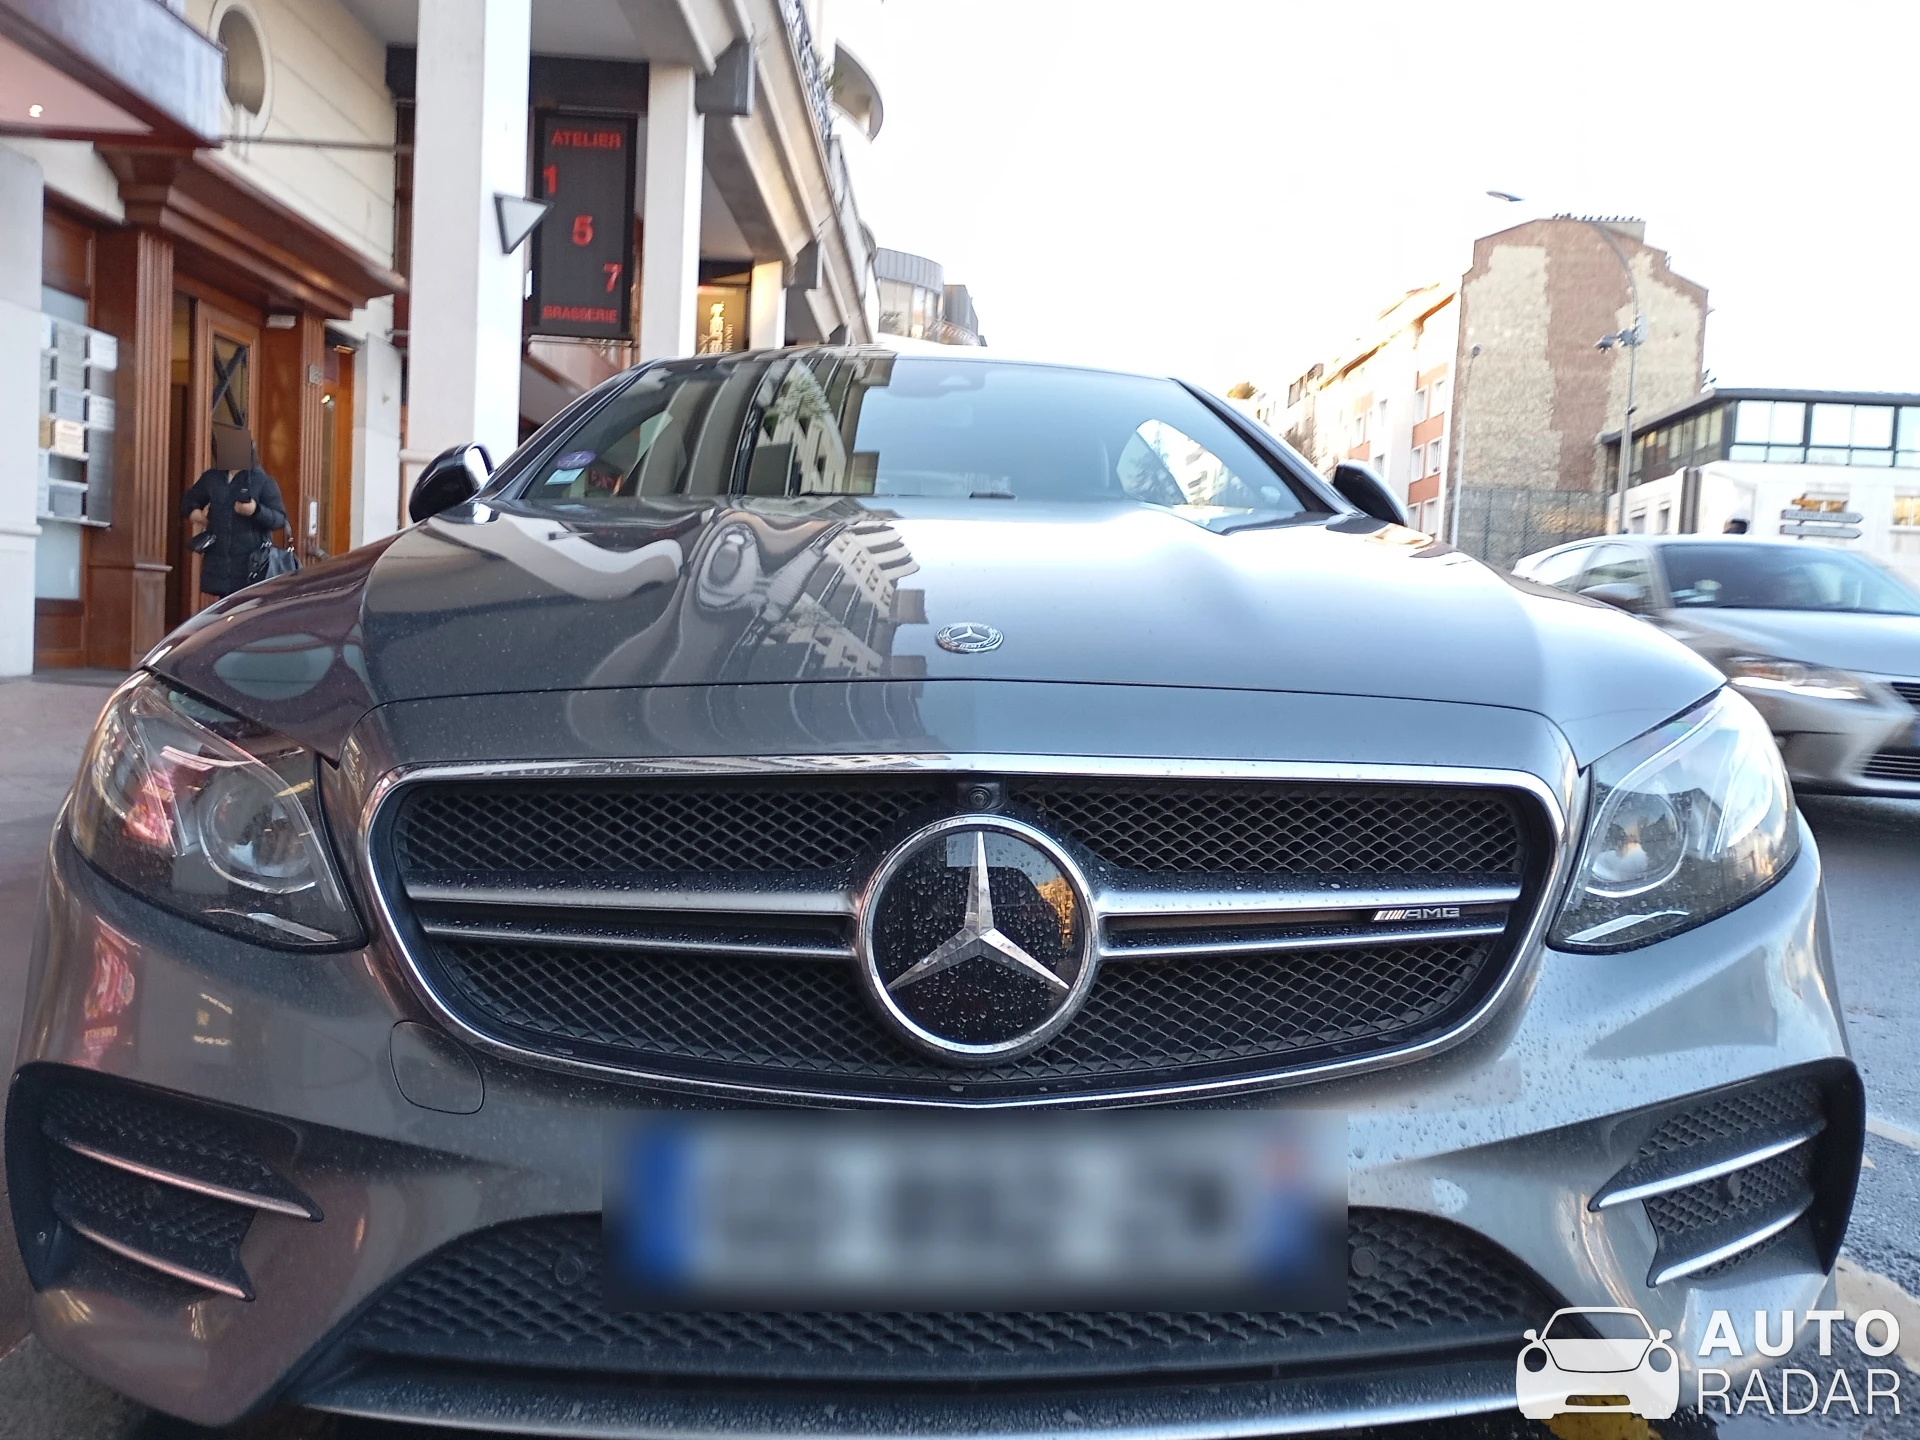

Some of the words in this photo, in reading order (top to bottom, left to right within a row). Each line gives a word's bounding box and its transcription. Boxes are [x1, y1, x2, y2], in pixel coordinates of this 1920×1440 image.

[552, 129, 622, 148] ATELIER
[543, 164, 558, 194] 1
[603, 263, 622, 293] 7
[541, 304, 618, 323] BRASSERIE
[1402, 907, 1460, 919] AMG
